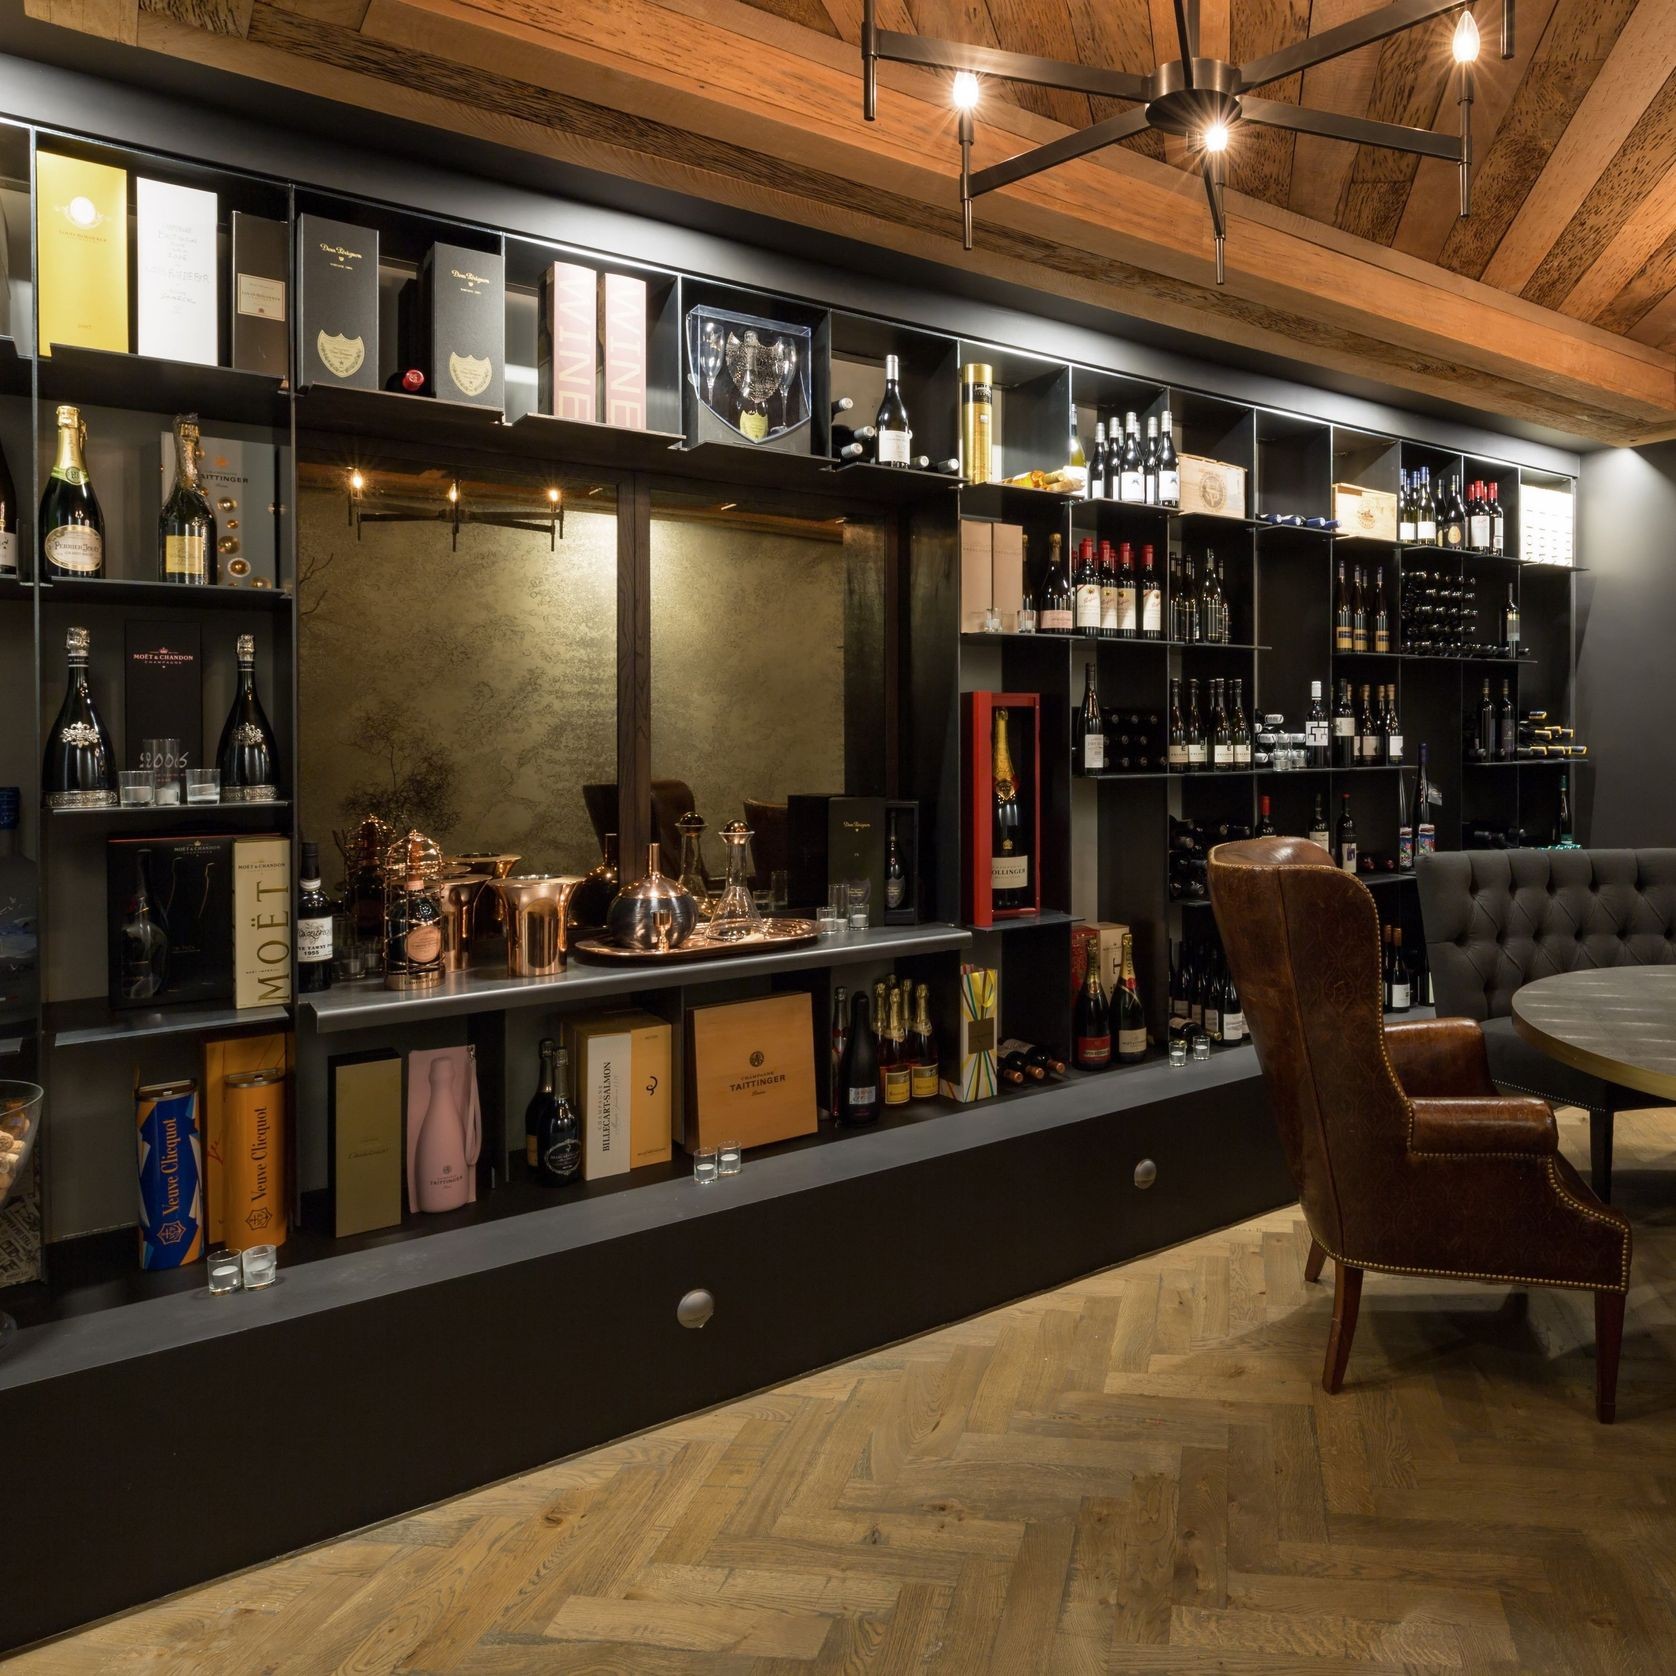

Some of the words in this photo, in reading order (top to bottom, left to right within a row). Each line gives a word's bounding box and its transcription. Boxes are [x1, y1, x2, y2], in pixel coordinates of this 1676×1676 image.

[200, 473, 249, 485] AITTINGER
[251, 881, 290, 1002] MOËT
[602, 1061, 612, 1152] BILLECART-SALMON
[729, 1074, 786, 1092] TAITTINGER
[160, 1117, 182, 1175] Clicquot
[250, 1106, 271, 1161] Clicquot
[162, 1177, 180, 1216] Veuve
[250, 1163, 268, 1202] Veuve
